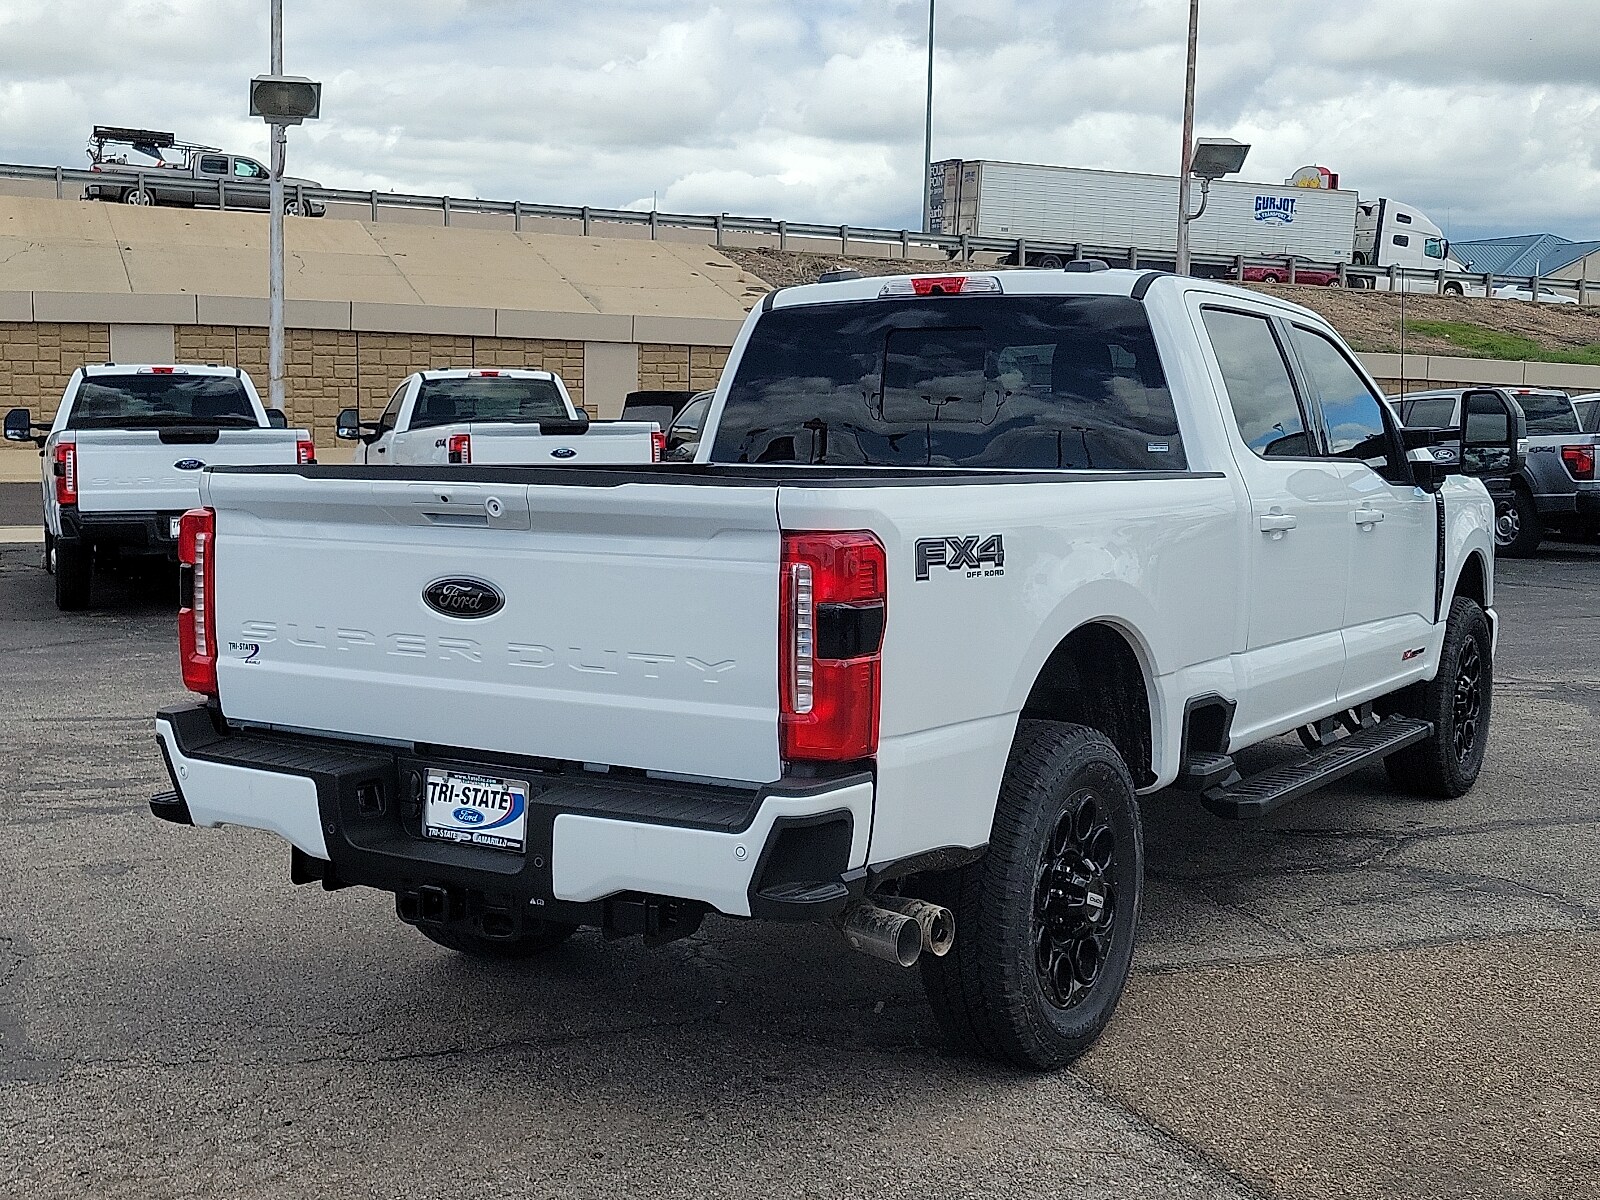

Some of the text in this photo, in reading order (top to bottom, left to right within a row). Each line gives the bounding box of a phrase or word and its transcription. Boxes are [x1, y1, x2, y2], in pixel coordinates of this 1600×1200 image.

[1255, 196, 1296, 214] GURJOT
[181, 460, 199, 469] Ford
[915, 534, 1005, 581] FX4
[966, 569, 1005, 578] OFF ROAD
[439, 584, 483, 610] Ford
[228, 642, 255, 651] TRI-STATE
[242, 620, 736, 683] SUPER DUTY
[428, 782, 511, 811] TRI-STATE
[458, 809, 479, 822] Ford
